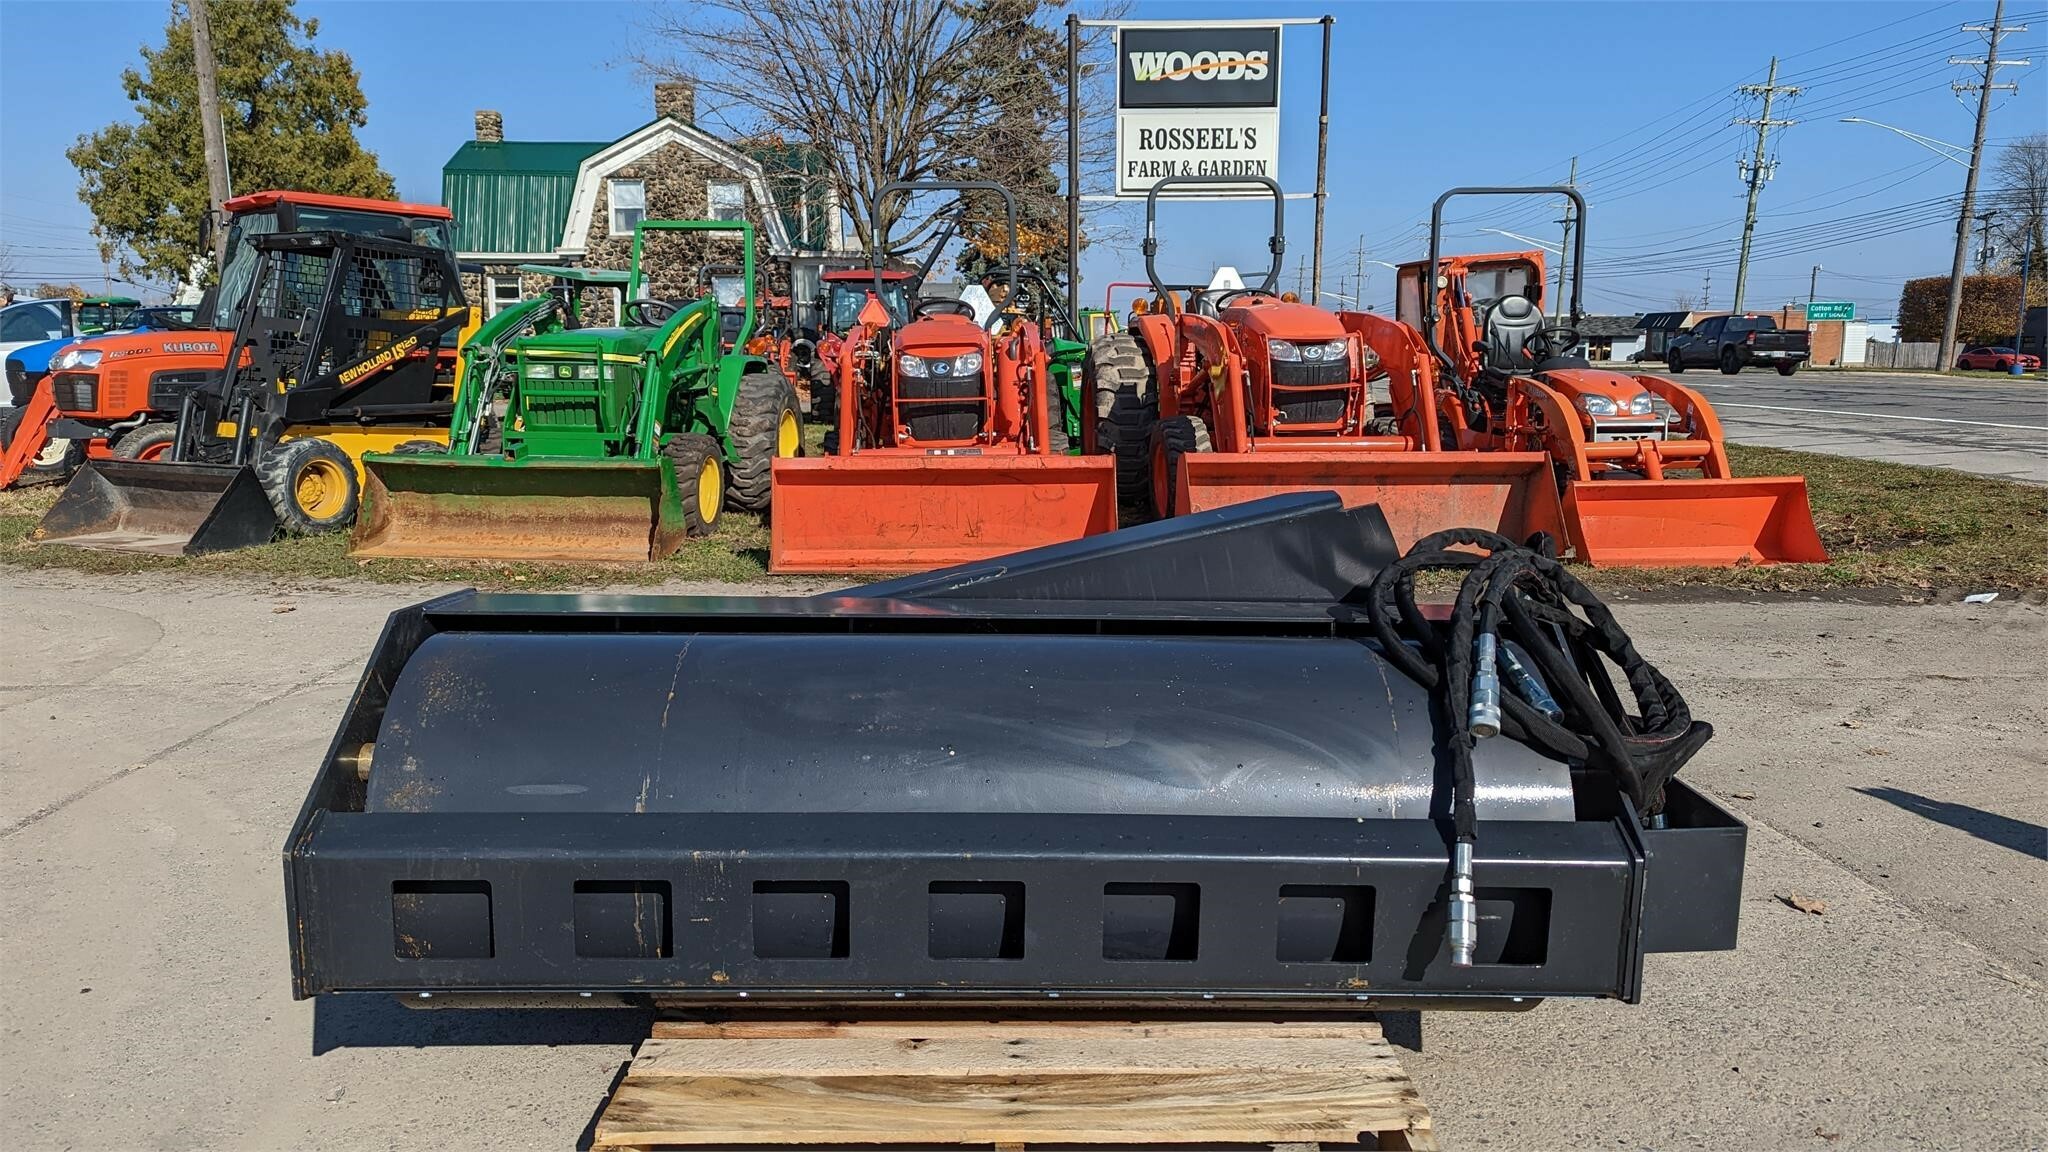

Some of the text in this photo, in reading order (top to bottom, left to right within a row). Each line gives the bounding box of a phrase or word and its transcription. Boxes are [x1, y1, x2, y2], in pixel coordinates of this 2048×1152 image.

[1129, 51, 1269, 81] WOODS
[1139, 127, 1257, 151] ROSSEEL'S
[1128, 160, 1268, 178] FARM & GARDEN
[163, 342, 220, 353] KUBOTA
[339, 368, 358, 384] NEW
[356, 351, 392, 375] HOLLAND
